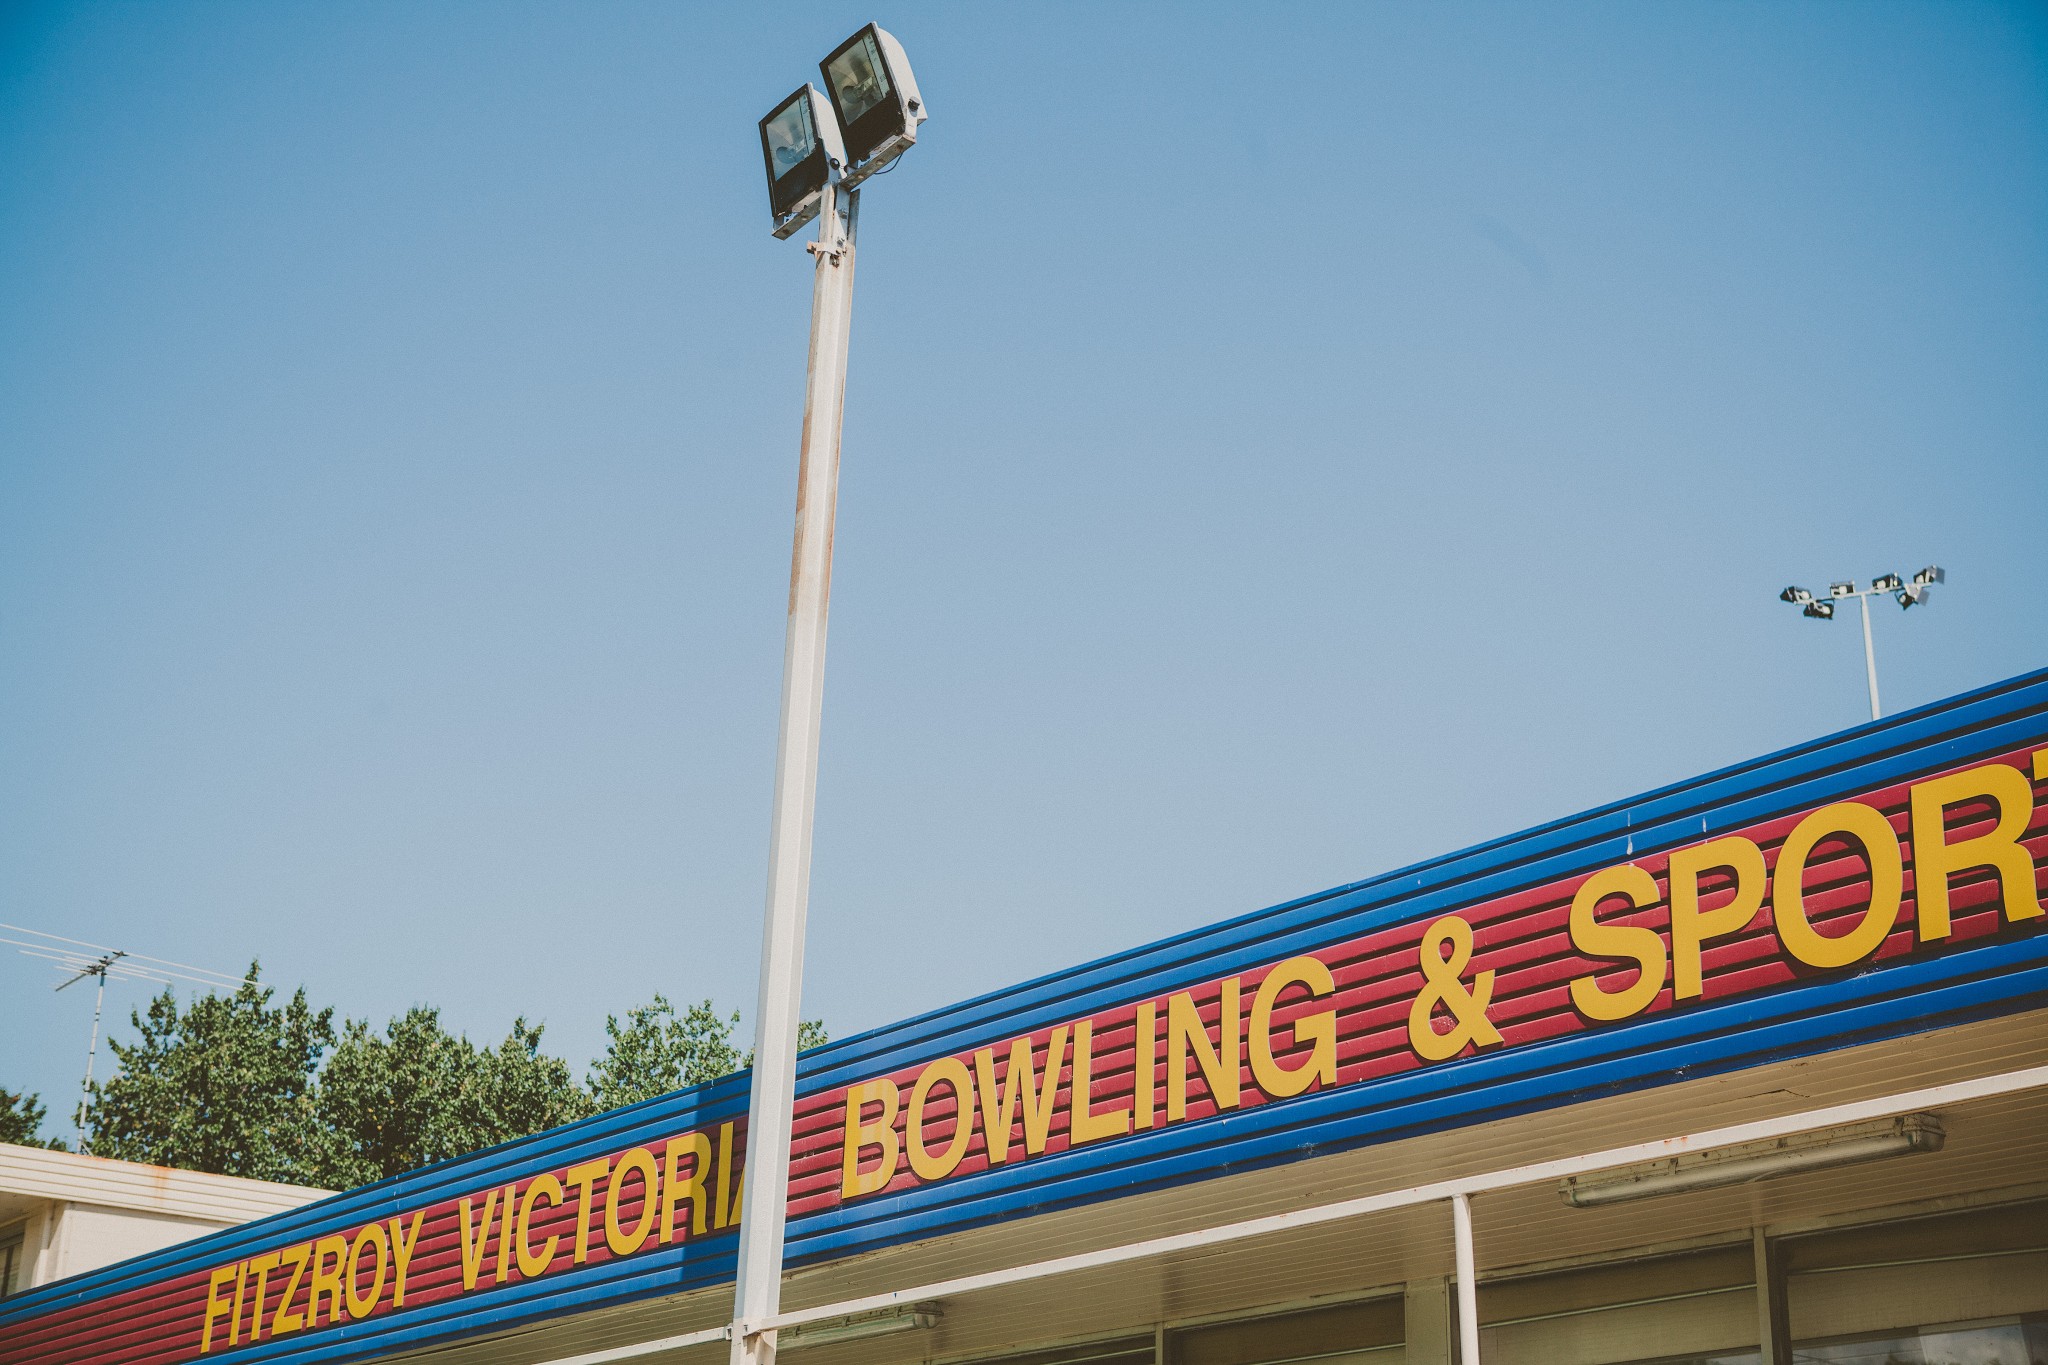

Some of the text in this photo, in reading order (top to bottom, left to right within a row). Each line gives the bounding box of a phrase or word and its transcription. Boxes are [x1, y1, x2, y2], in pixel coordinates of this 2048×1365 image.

[201, 748, 2048, 1354] FITZROY VICTORI BOWLING & SPOR
